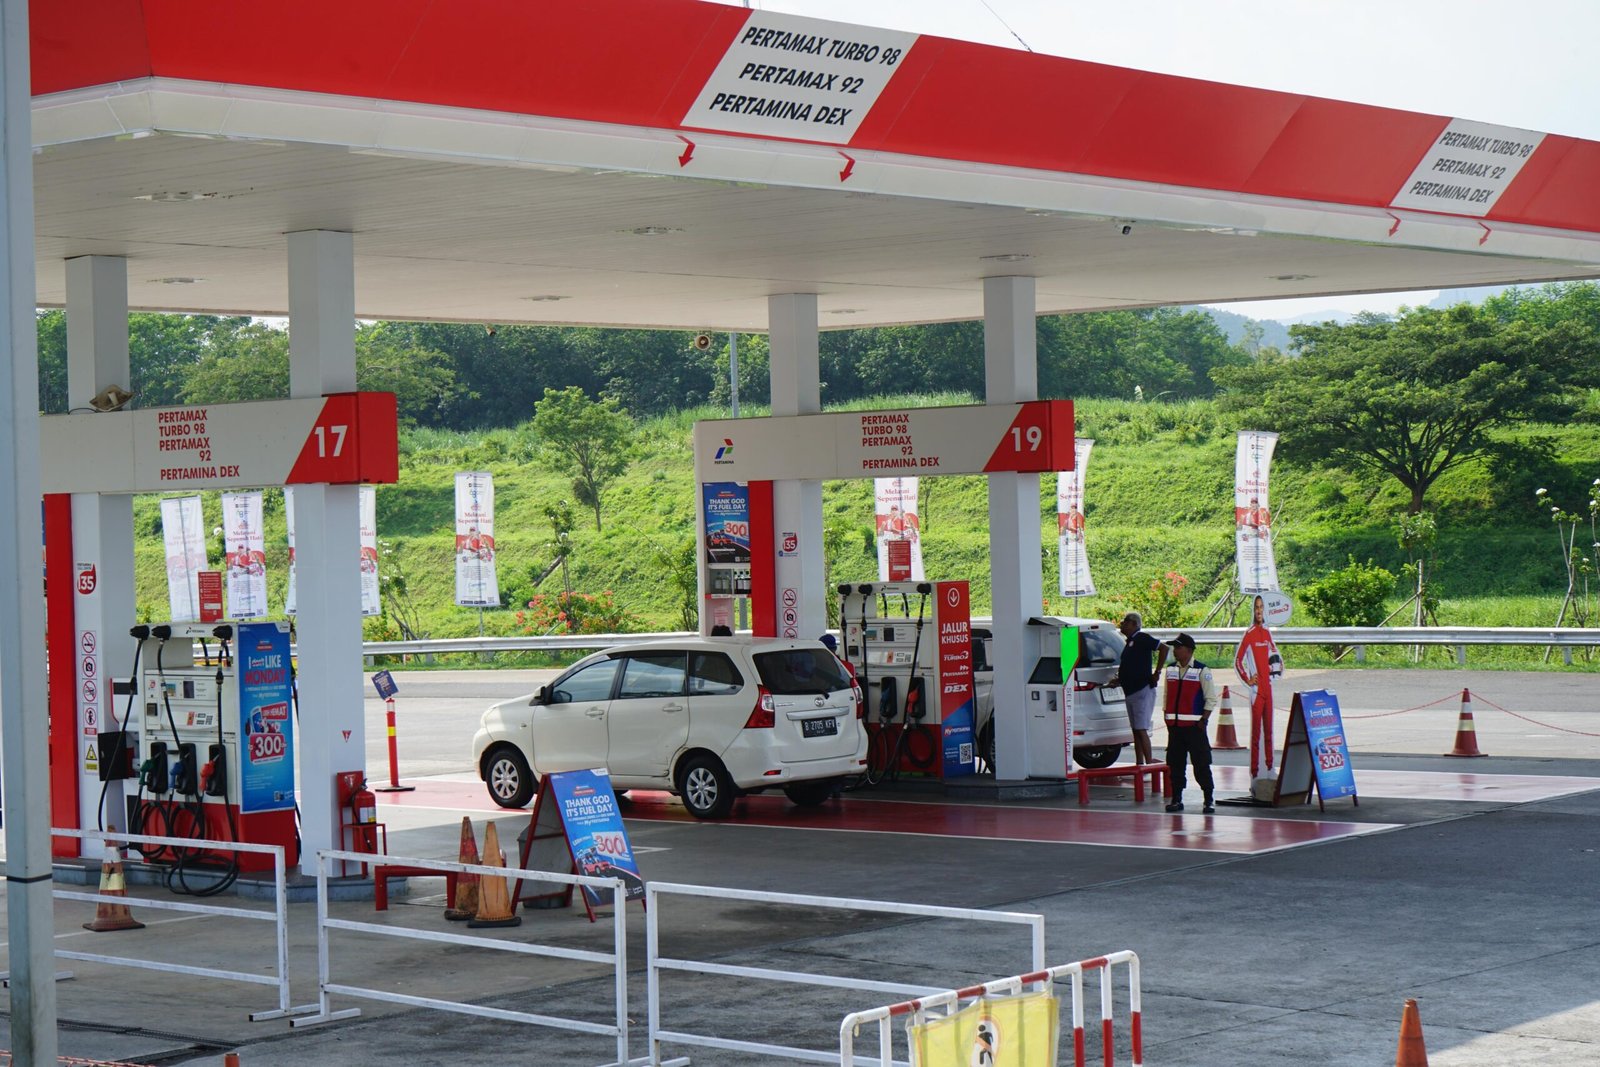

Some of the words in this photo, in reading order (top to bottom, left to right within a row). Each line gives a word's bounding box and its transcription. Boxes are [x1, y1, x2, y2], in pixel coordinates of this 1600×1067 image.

[741, 26, 829, 56] PERTAMAX
[826, 40, 880, 63] TURBO
[878, 48, 902, 66] 98
[738, 63, 839, 91] PERTAMAX
[840, 77, 864, 94] 92
[709, 92, 812, 122] PERTAMINA
[813, 106, 853, 126] DEX
[1438, 132, 1490, 152] PERTAMAX
[1488, 140, 1520, 156] TURBO
[1518, 144, 1534, 158] 98
[1432, 158, 1492, 178] PERTAMAX
[1490, 166, 1506, 180] 92
[1409, 181, 1470, 202] PERTAMINA
[1469, 188, 1494, 204] DEX
[158, 409, 208, 423] PERTAMAX
[862, 414, 909, 424] PERTAMAX
[159, 424, 190, 437] TURBO
[194, 423, 205, 434] 98
[862, 425, 893, 435] TURBO
[896, 425, 907, 433] 98
[160, 437, 210, 451] PERTAMAX
[314, 425, 348, 457] 17
[862, 436, 912, 447] PERTAMAX
[1011, 426, 1042, 451] 19
[199, 450, 211, 462] 92
[902, 446, 913, 455] 92
[863, 458, 917, 469] PERTAMINA
[920, 457, 939, 467] DEX
[161, 466, 217, 480] PERTAMINA
[220, 465, 240, 478] DEX
[725, 522, 747, 536] 300
[784, 540, 796, 550] 135
[78, 576, 94, 590] 135
[942, 622, 968, 634] JALUR
[942, 634, 968, 644] KHUSUS
[265, 654, 281, 668] LIKE
[245, 669, 286, 685] MONDAY
[944, 684, 968, 693] DEX
[1322, 708, 1333, 716] LIKE
[256, 736, 281, 757] 300
[1323, 755, 1341, 768] 300
[565, 797, 591, 808] THANK
[593, 795, 610, 804] GOD
[566, 808, 578, 817] IT'S
[579, 806, 596, 815] FUEL
[597, 804, 613, 813] DAY
[595, 835, 626, 856] 300
